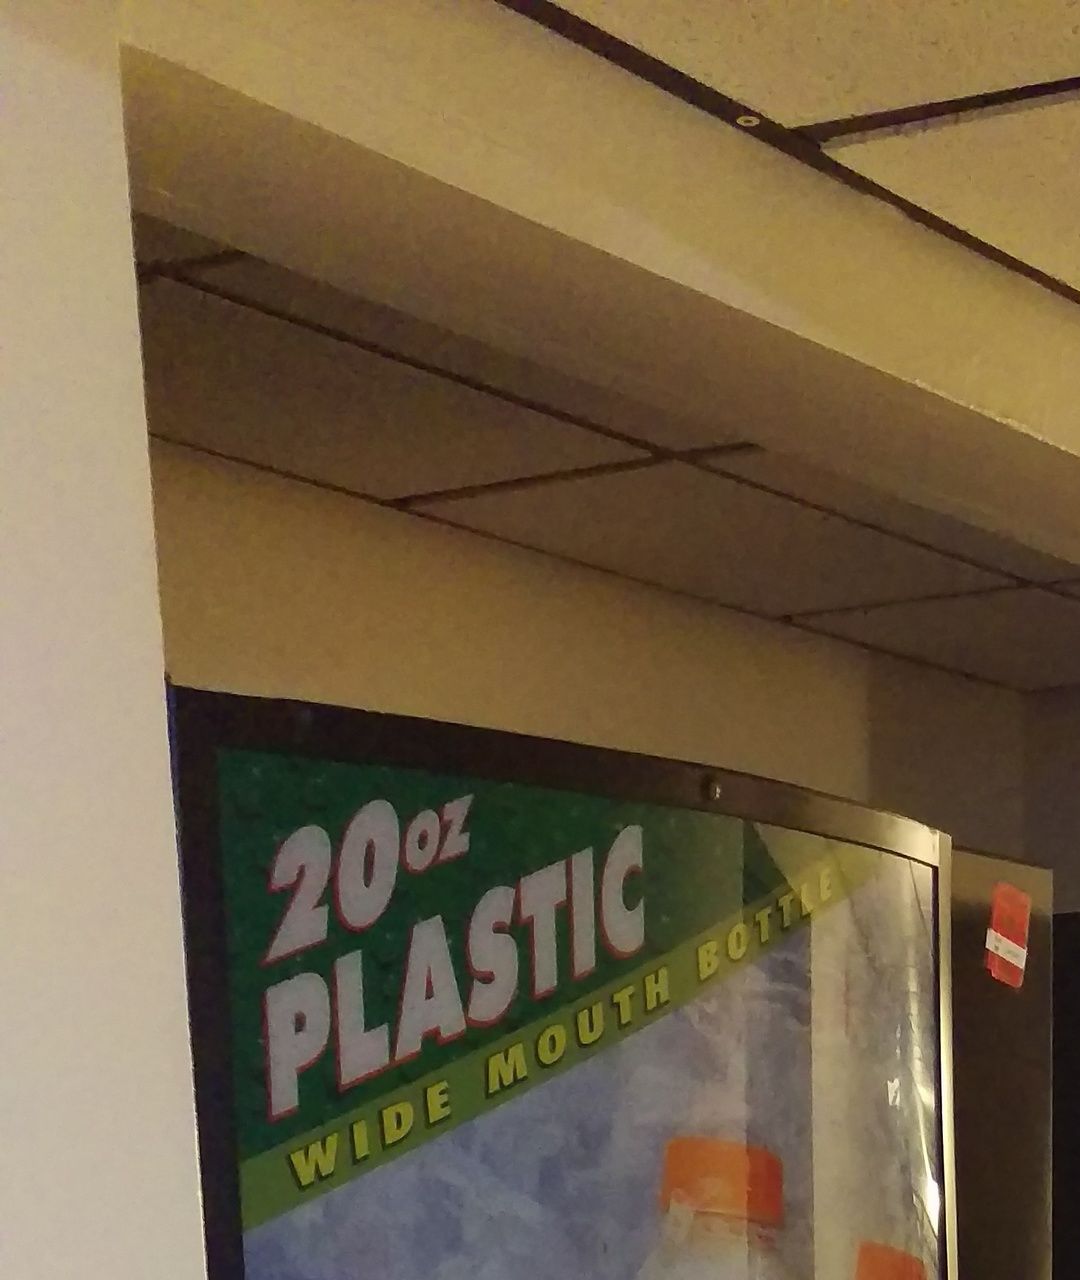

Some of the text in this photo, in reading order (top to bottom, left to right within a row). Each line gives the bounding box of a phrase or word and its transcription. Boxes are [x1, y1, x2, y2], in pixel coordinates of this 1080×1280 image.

[263, 824, 647, 1123] PLASTIC
[265, 798, 401, 966] 20
[289, 864, 836, 1191] WIDE MOUTH BOTTLE
